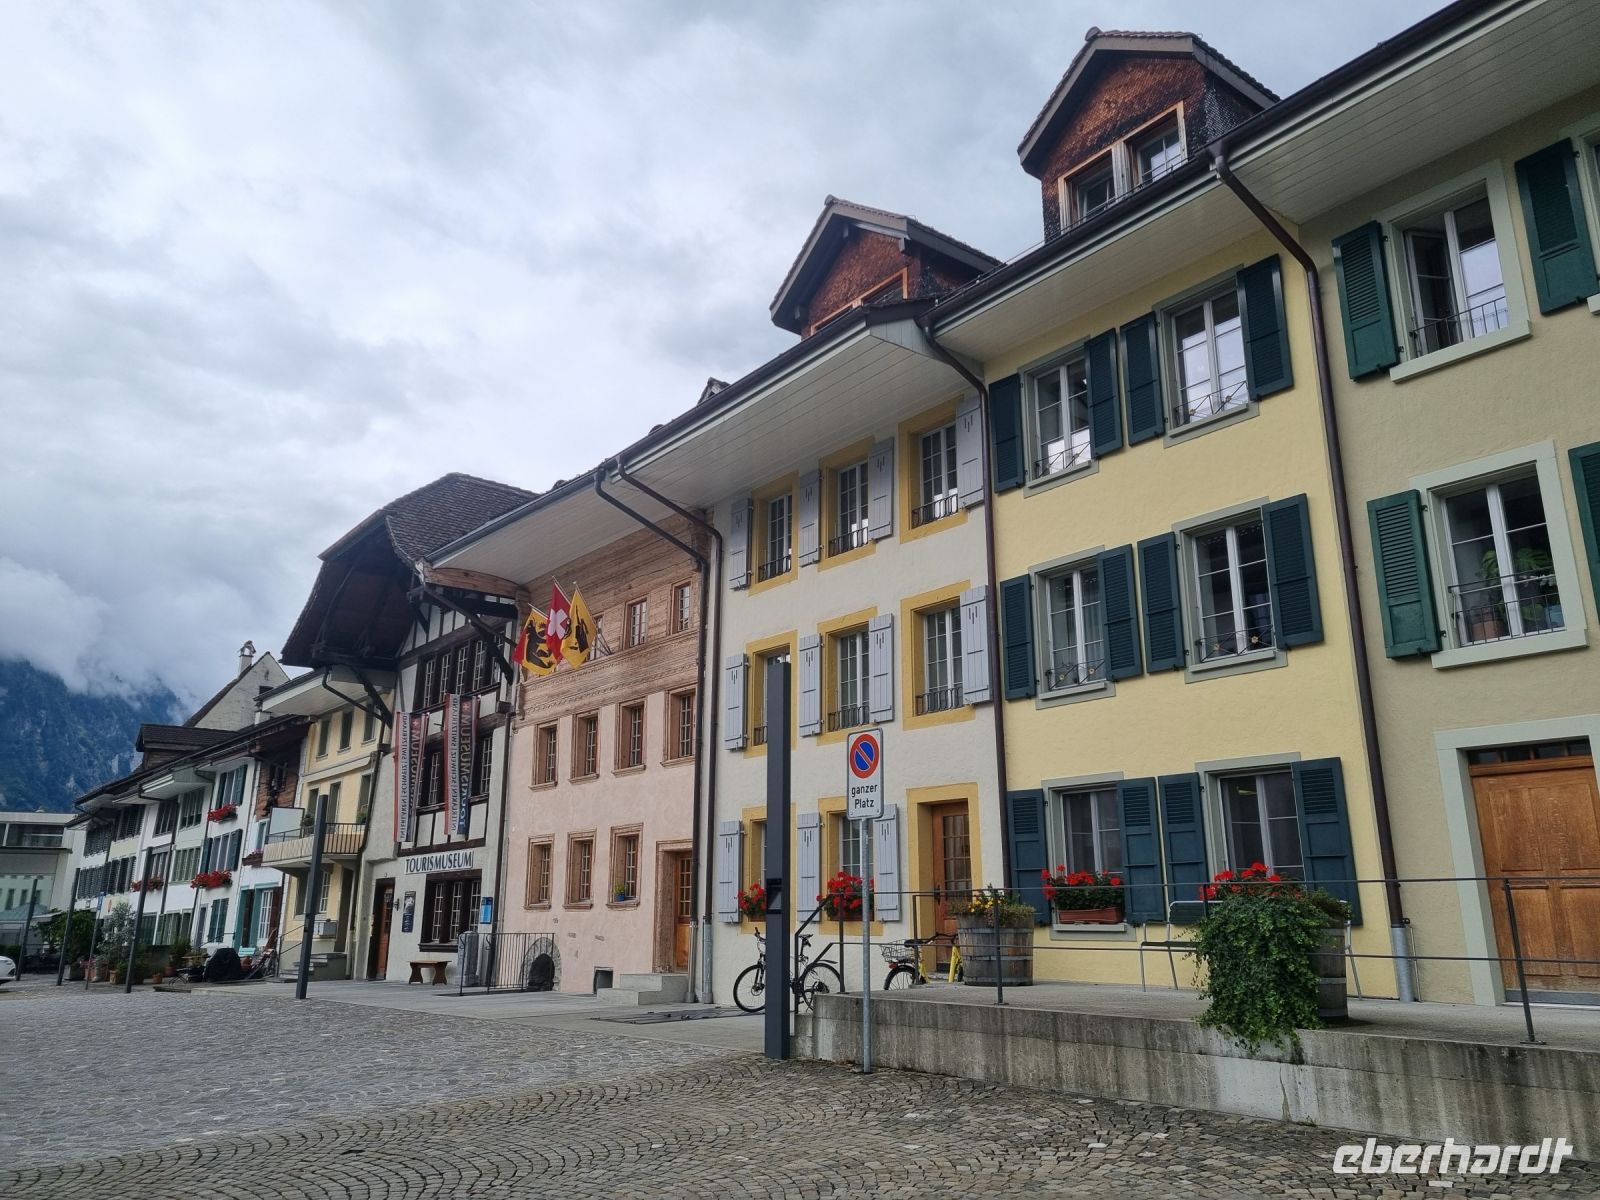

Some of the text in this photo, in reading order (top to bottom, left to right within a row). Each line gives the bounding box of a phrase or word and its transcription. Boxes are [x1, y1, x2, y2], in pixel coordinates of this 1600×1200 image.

[851, 784, 878, 798] ganzer
[854, 798, 875, 809] Platz
[405, 850, 472, 873] TOURISMUSEUM
